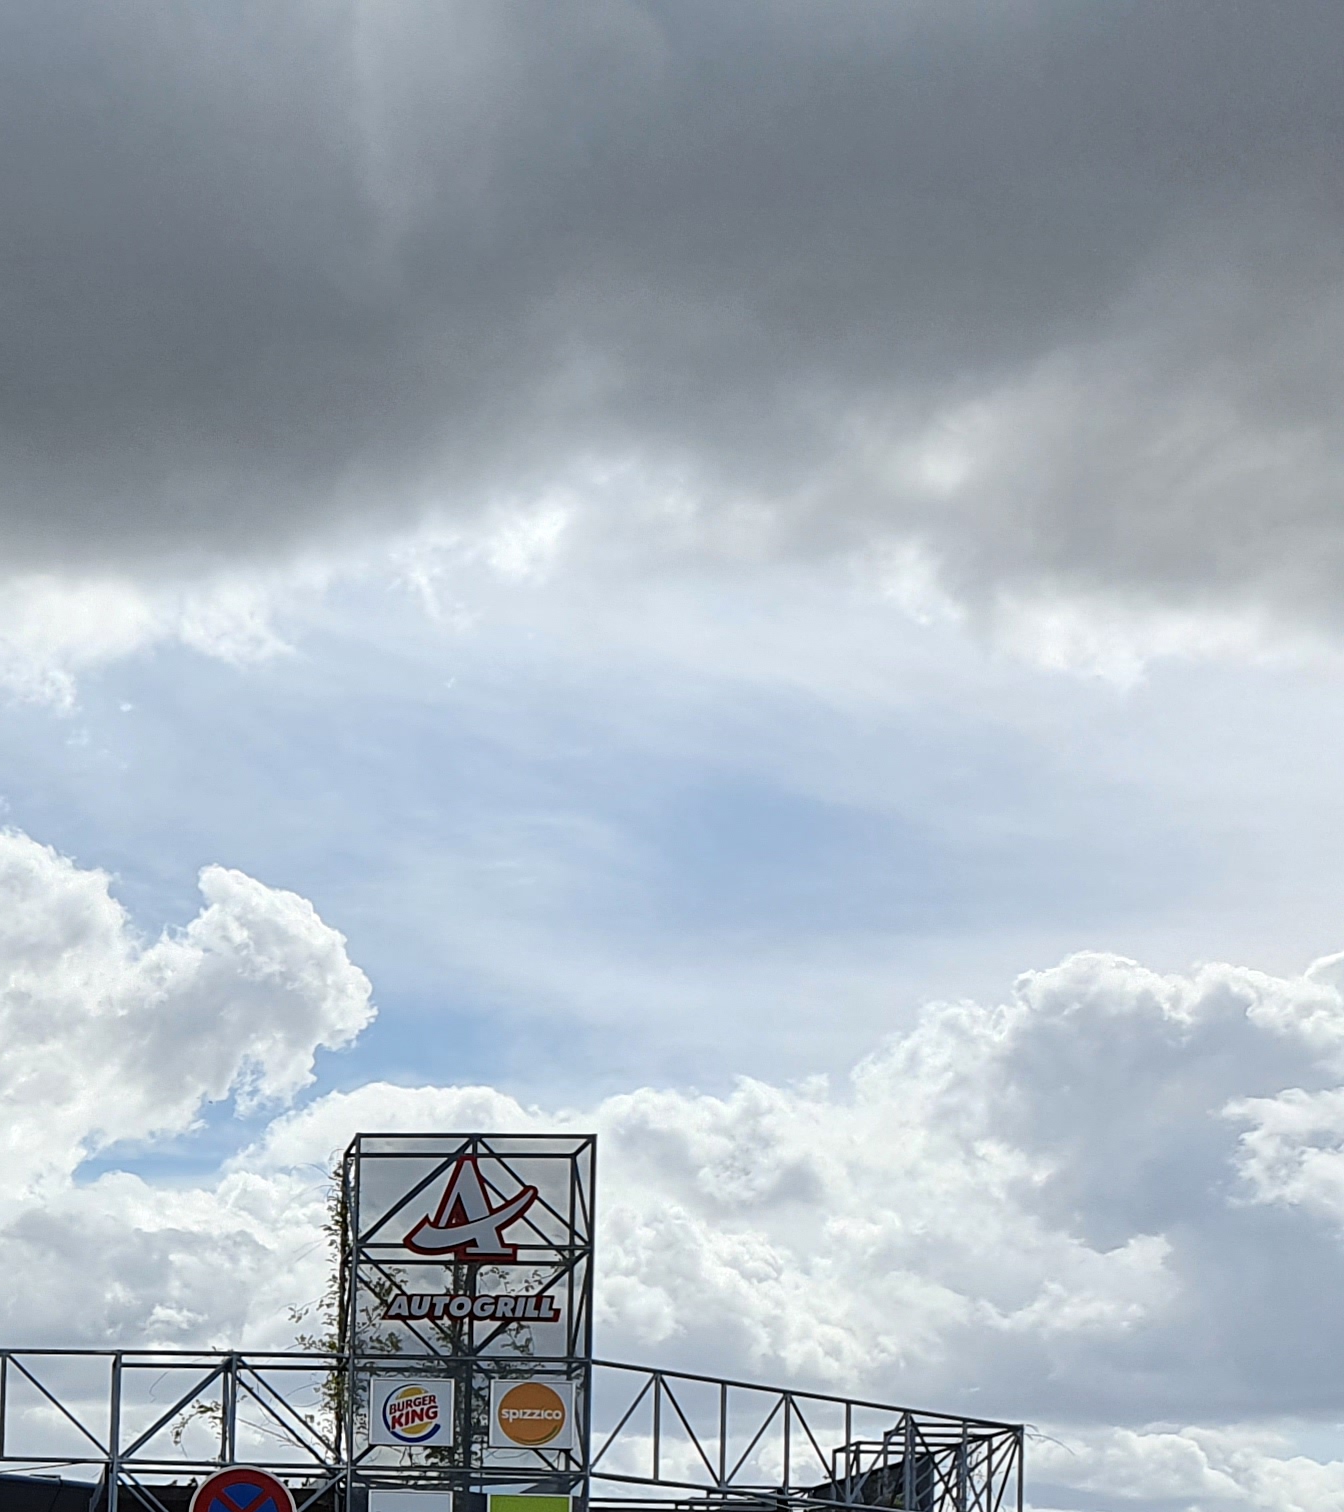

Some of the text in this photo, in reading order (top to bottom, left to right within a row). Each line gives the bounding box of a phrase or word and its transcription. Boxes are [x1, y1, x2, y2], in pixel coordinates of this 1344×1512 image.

[384, 1293, 559, 1320] AUTOGRILL
[389, 1394, 437, 1416] BURGER
[501, 1408, 562, 1423] spizzico
[391, 1405, 439, 1430] KING
